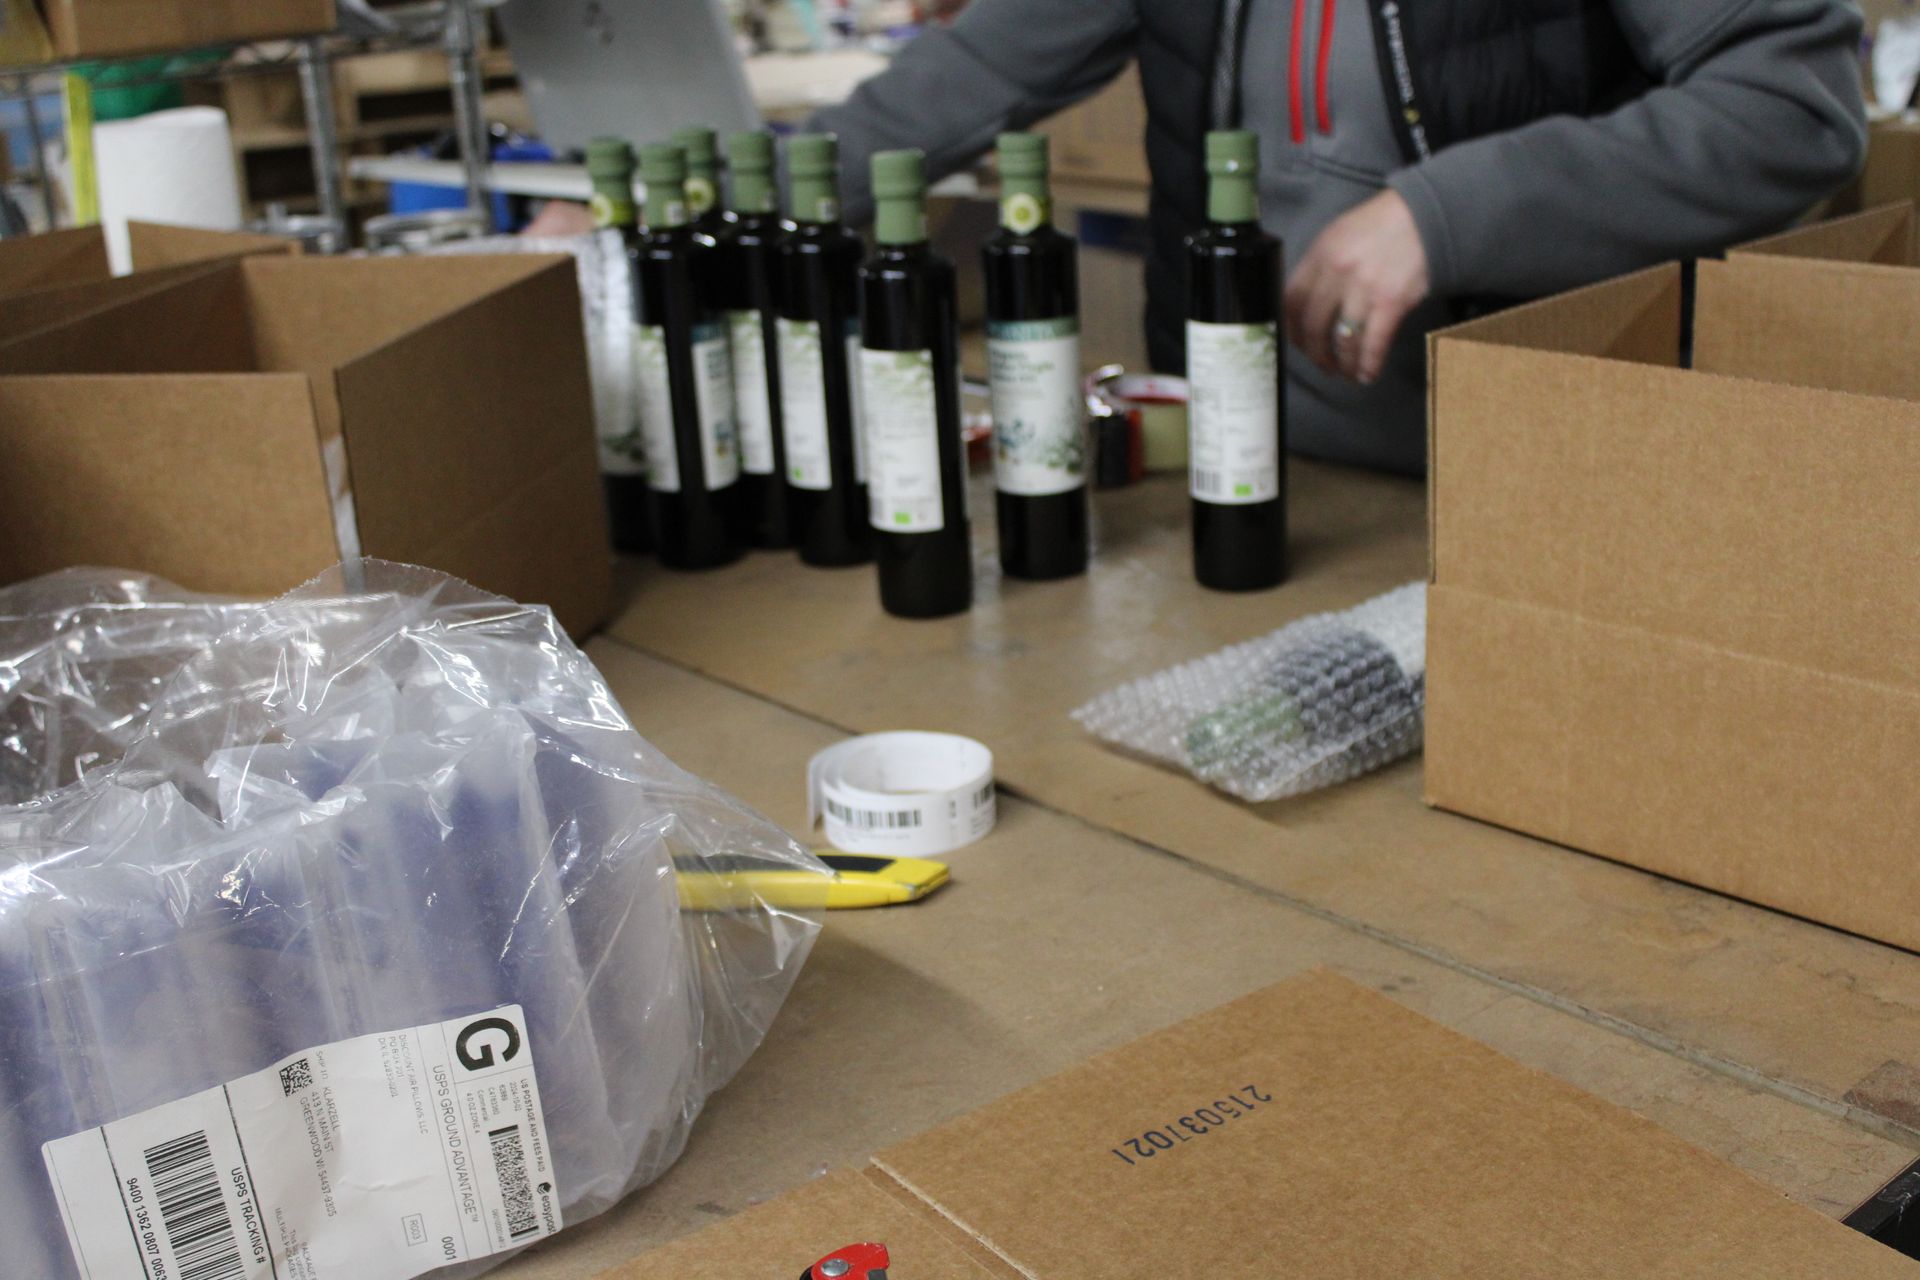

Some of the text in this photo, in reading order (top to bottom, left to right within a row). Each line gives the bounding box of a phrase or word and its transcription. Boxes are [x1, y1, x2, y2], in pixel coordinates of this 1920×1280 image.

[456, 1017, 521, 1071] G
[431, 1064, 449, 1096] USPS
[310, 1090, 321, 1107] 413
[299, 1096, 322, 1157] GREENWOOD
[317, 1116, 330, 1140] MAIN
[438, 1097, 462, 1148] GROUND
[519, 1078, 546, 1171] US POSTAGE AND FEES PAID
[1111, 1084, 1272, 1165] 215037021
[323, 1141, 334, 1153] ST
[126, 1177, 143, 1203] 9400
[134, 1204, 151, 1231] 1362
[230, 1166, 267, 1264] USPS TRACKING #
[541, 1195, 558, 1234] easypost
[142, 1231, 159, 1256] 0807
[440, 1235, 457, 1260] 0001
